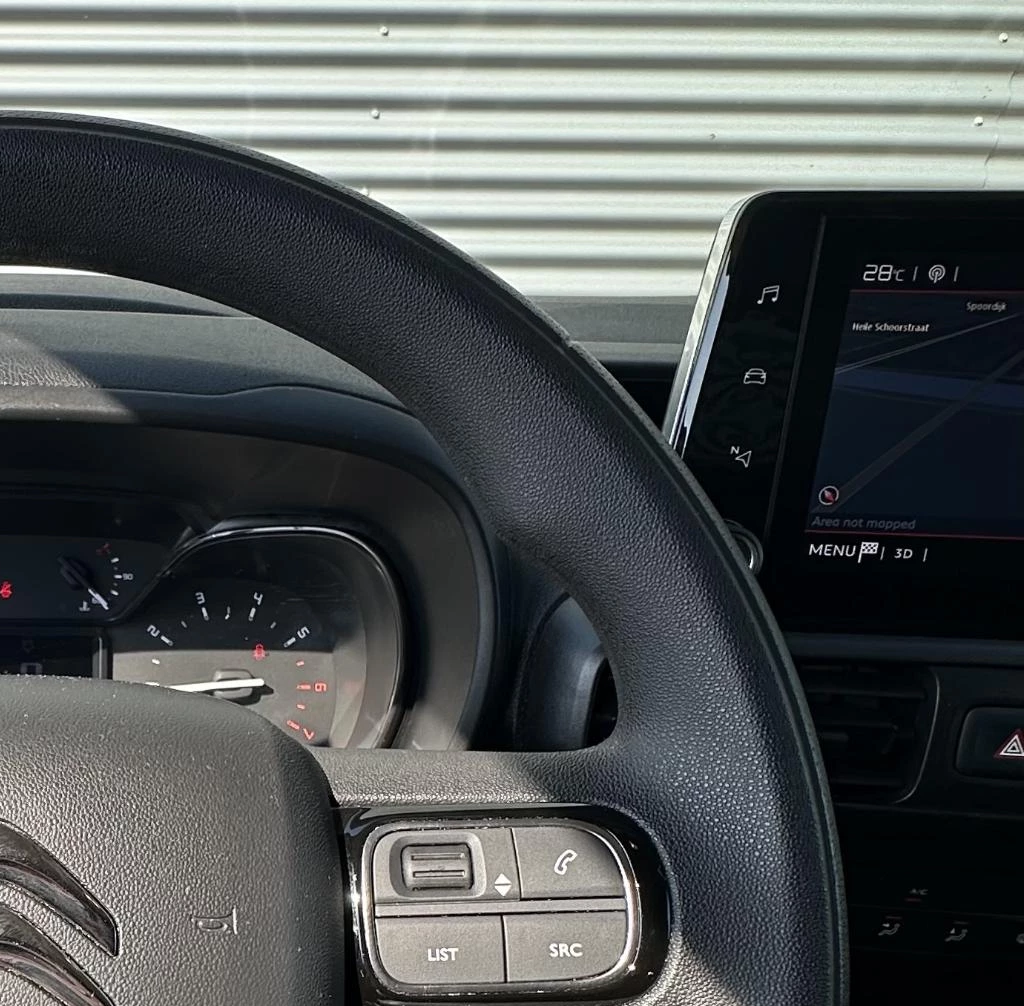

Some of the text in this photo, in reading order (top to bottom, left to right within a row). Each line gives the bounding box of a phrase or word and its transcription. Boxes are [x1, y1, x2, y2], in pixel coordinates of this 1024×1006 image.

[811, 516, 916, 531] Area not mapped
[808, 543, 856, 557] MENU
[894, 548, 913, 559] 3D
[195, 592, 206, 605] 3
[253, 592, 263, 605] 4
[147, 624, 160, 637] 2
[297, 626, 310, 639] 5
[314, 682, 327, 692] 6
[303, 728, 314, 740] 7
[427, 948, 459, 961] LIST
[549, 943, 584, 958] SRC
